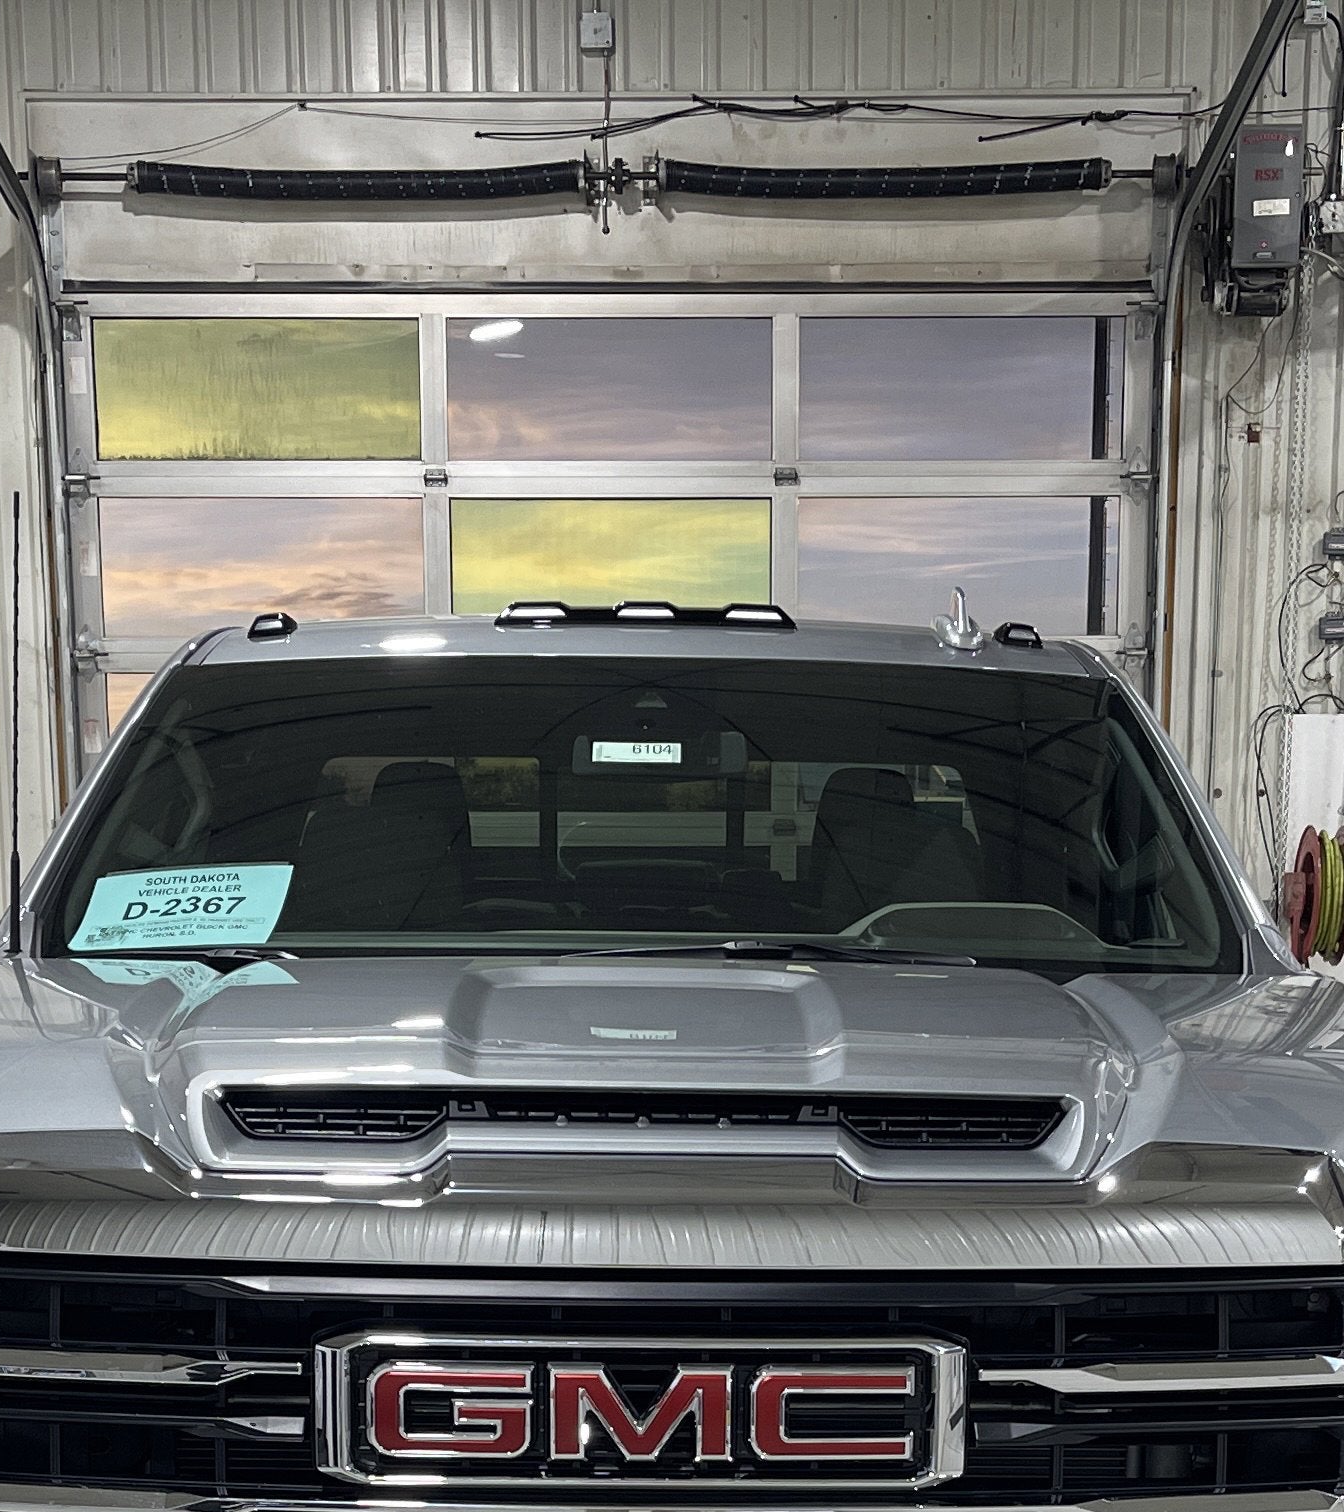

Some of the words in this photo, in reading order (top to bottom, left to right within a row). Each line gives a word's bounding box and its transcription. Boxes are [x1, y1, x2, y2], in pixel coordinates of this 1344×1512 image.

[1254, 168, 1280, 182] RSX
[632, 744, 672, 754] 6104
[145, 875, 187, 886] SOUTH
[190, 873, 241, 884] DAKOTA
[138, 886, 189, 897] VEHICLE
[192, 884, 242, 893] DEALER
[122, 896, 247, 920] D-2367
[367, 1361, 917, 1462] GMC
